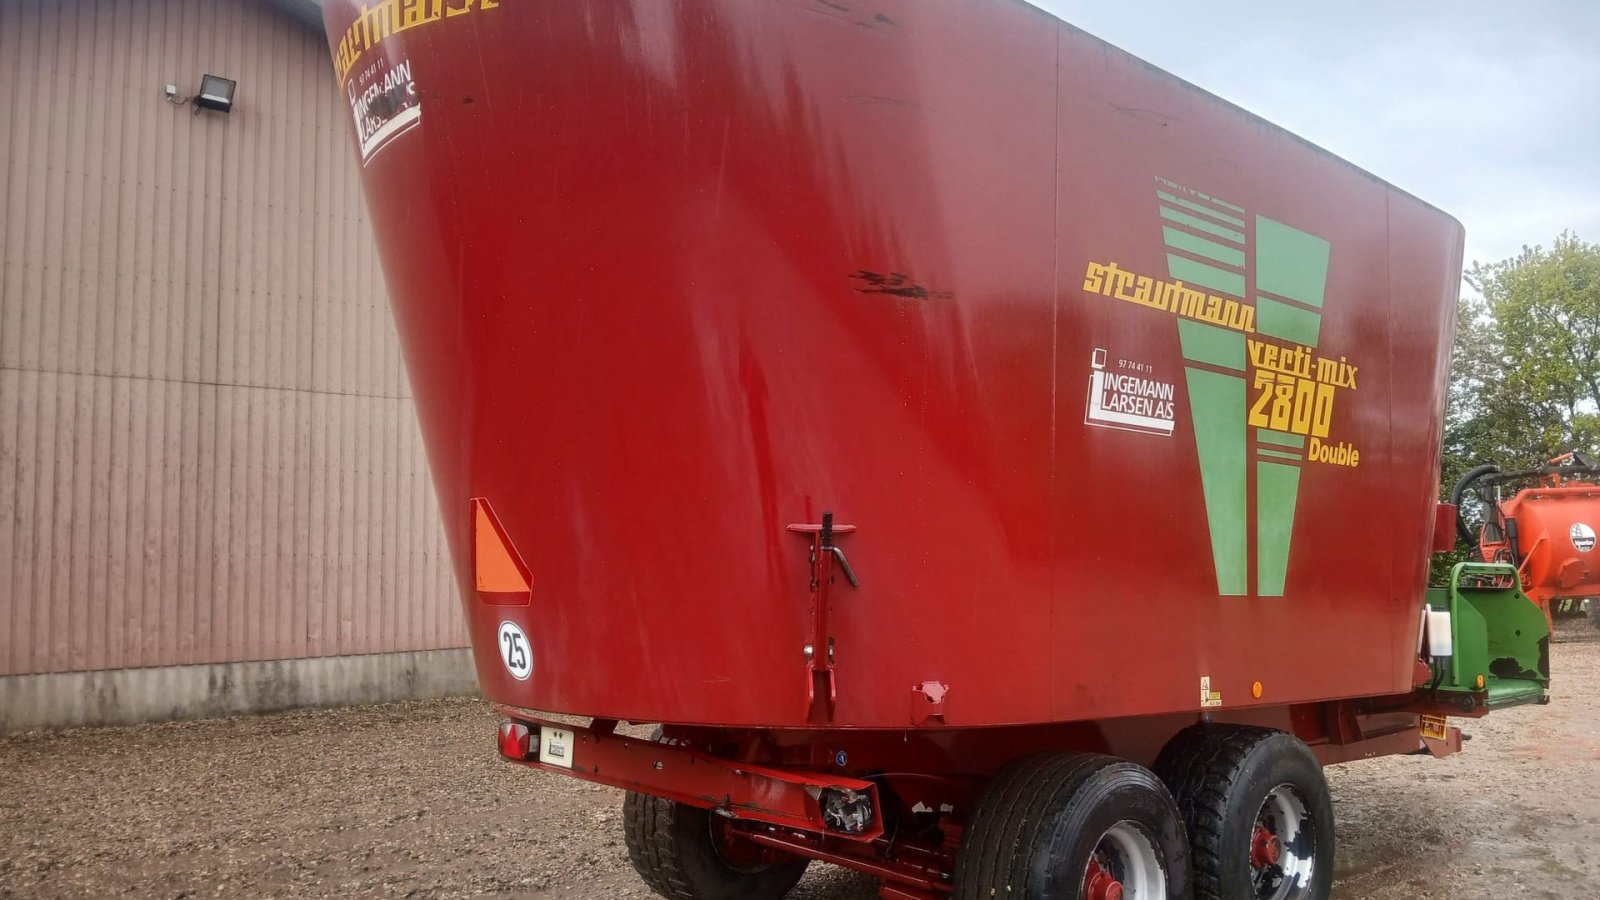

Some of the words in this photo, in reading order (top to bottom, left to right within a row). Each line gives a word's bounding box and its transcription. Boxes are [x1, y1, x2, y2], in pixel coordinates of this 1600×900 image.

[1082, 261, 1255, 333] strautmann
[1118, 359, 1127, 368] 97
[1127, 361, 1135, 370] 74
[1136, 363, 1144, 372] 41
[1145, 365, 1152, 374] 11
[1247, 339, 1358, 390] verti-mix
[1104, 372, 1174, 401] INGEMANN
[1248, 369, 1335, 438] 2800
[1102, 391, 1153, 417] LARSEN
[1154, 401, 1175, 420] A/S
[1308, 436, 1360, 467] Double
[503, 631, 527, 670] 25
